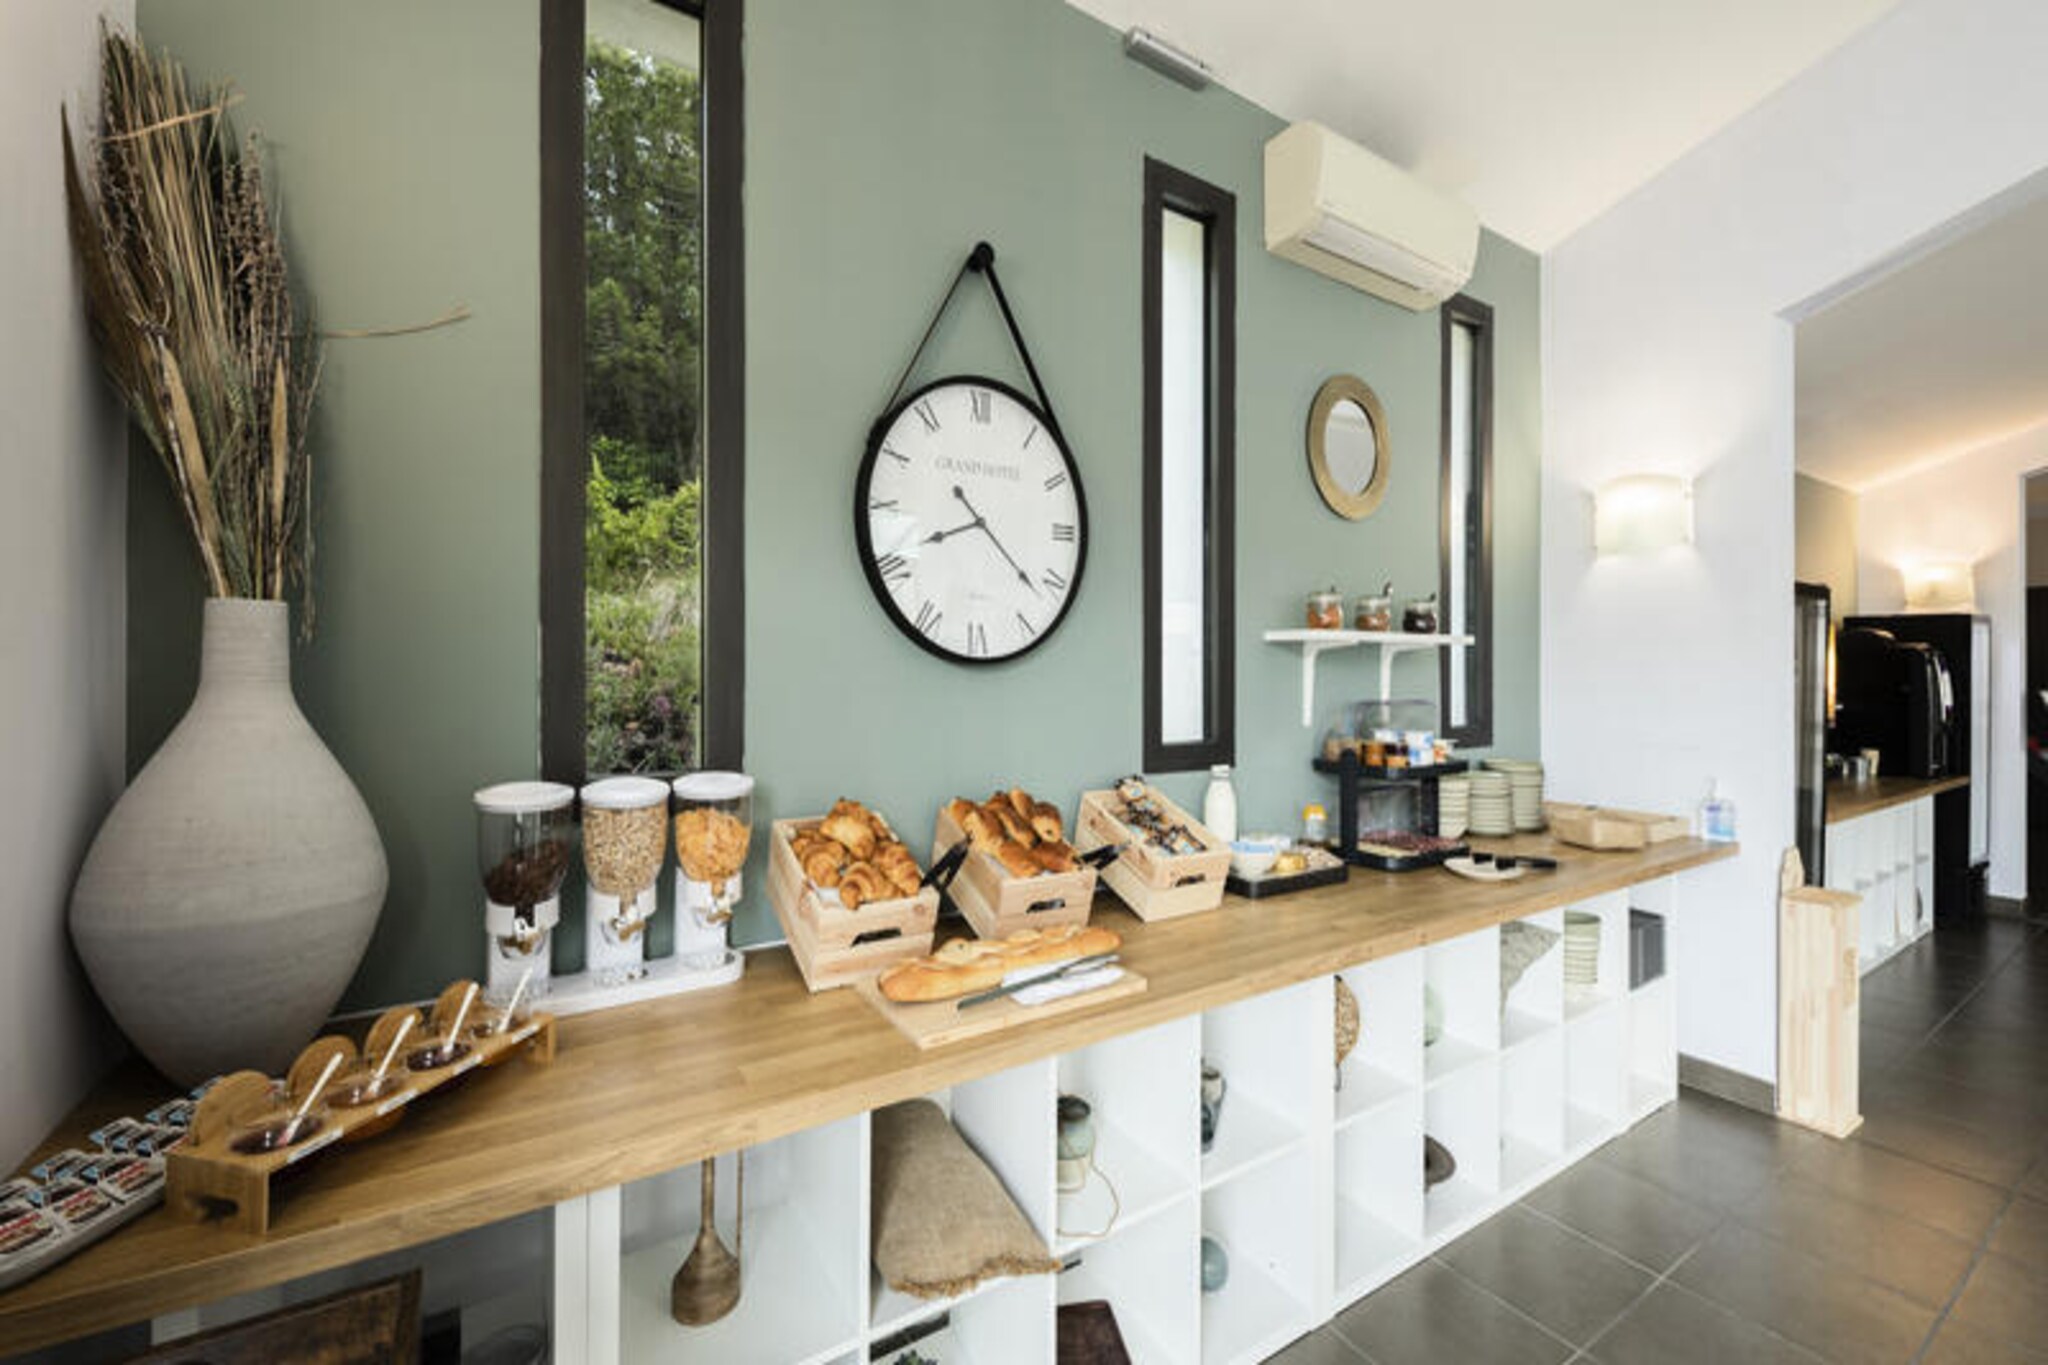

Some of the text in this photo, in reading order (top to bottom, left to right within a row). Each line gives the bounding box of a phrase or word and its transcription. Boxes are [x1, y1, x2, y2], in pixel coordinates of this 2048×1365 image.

[934, 456, 1021, 481] GRAND HOTEL
[1052, 522, 1075, 542] III
